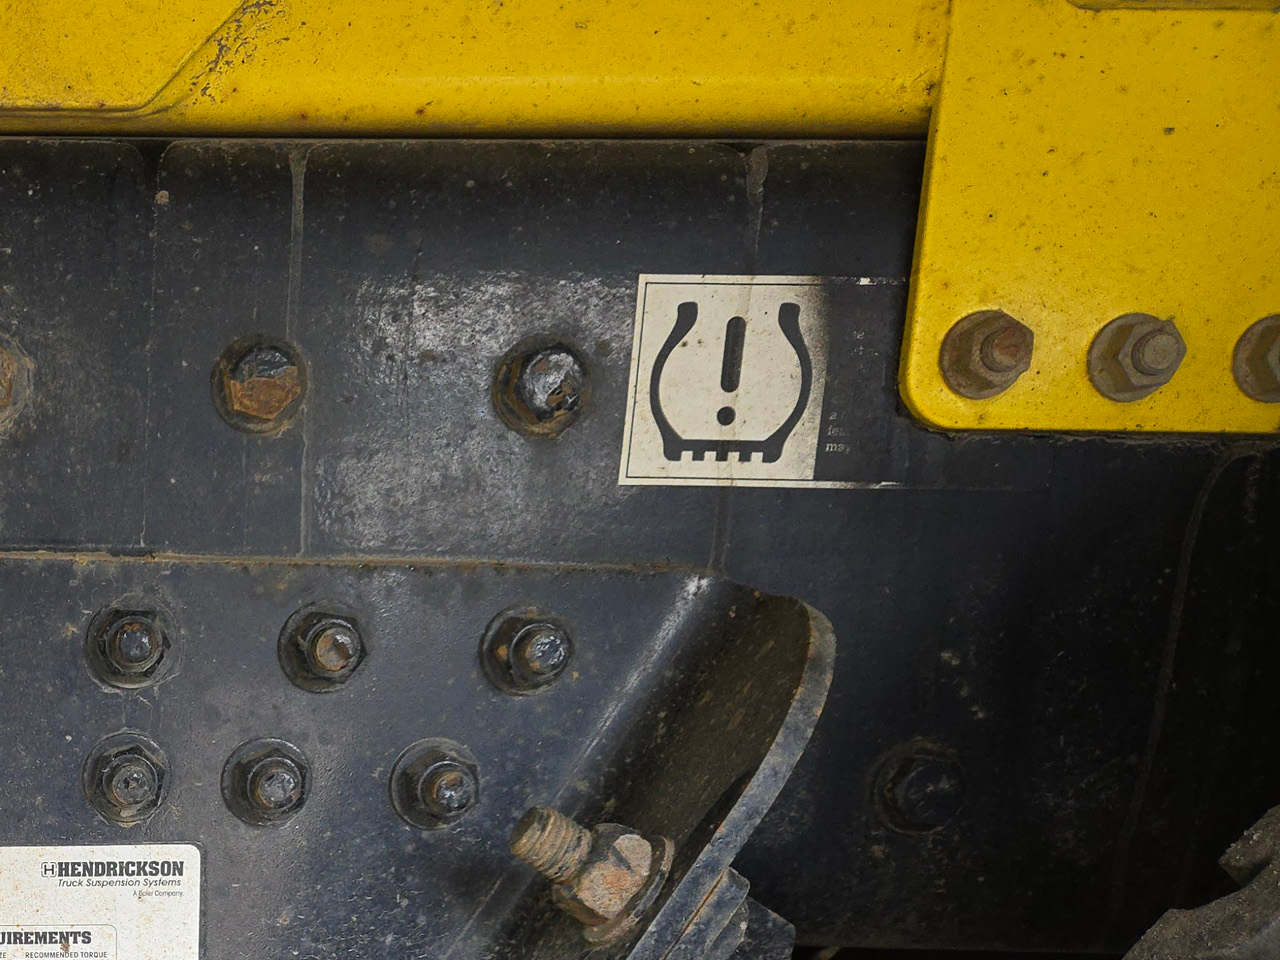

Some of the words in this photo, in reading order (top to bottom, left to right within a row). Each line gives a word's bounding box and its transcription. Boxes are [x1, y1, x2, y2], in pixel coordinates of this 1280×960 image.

[57, 860, 185, 877] HENDRICKSON
[58, 878, 84, 888] Truck
[86, 878, 140, 888] Suspension
[143, 878, 182, 888] Systems
[25, 951, 79, 959] RECOMMENDED
[80, 951, 108, 959] TORQUE
